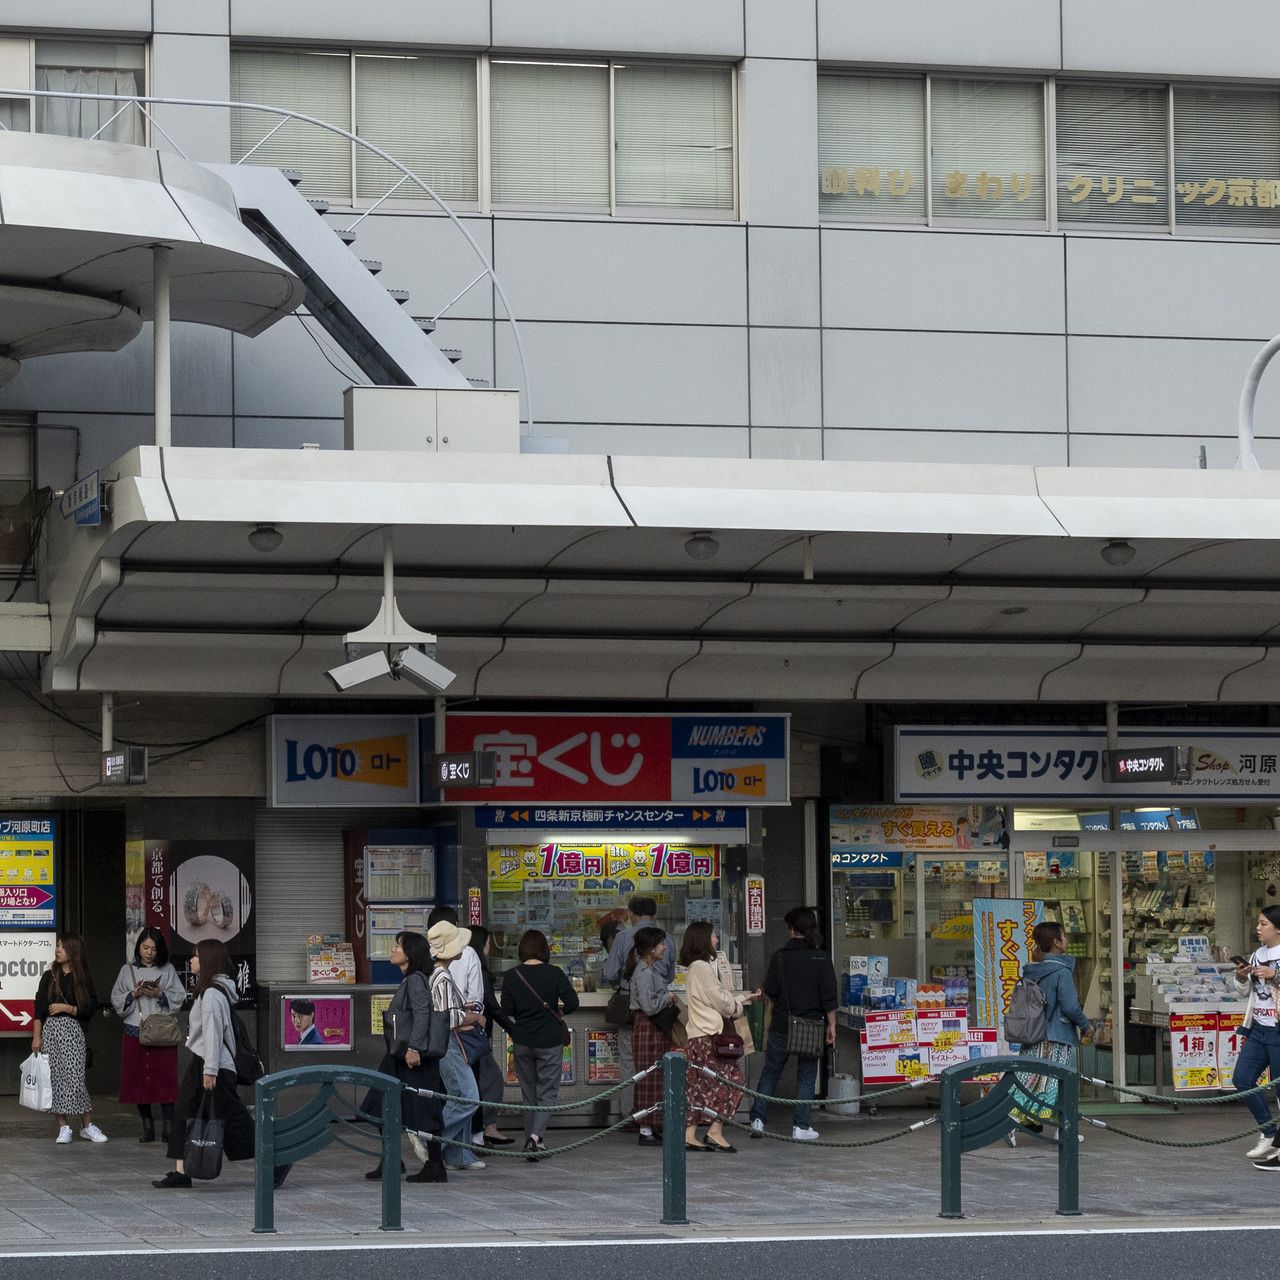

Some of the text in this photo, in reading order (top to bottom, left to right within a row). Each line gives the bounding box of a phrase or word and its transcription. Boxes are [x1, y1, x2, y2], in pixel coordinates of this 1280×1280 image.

[688, 724, 767, 747] NUMBERS
[285, 739, 357, 784] LOTO
[473, 728, 645, 788] 宝くじ
[1126, 757, 1165, 772] 中央コンタクト
[1195, 754, 1230, 774] Shop
[449, 763, 470, 779] 宝くじ
[693, 767, 735, 794] LOTO
[534, 809, 684, 822] 四条新京極前チャンスセンター
[881, 820, 955, 838] すぐ買える
[539, 843, 603, 876] 1億円
[649, 843, 713, 876] 1億円
[150, 847, 164, 918] 京都で創る、
[1179, 1034, 1205, 1052] 1箱
[26, 1074, 37, 1086] GU
